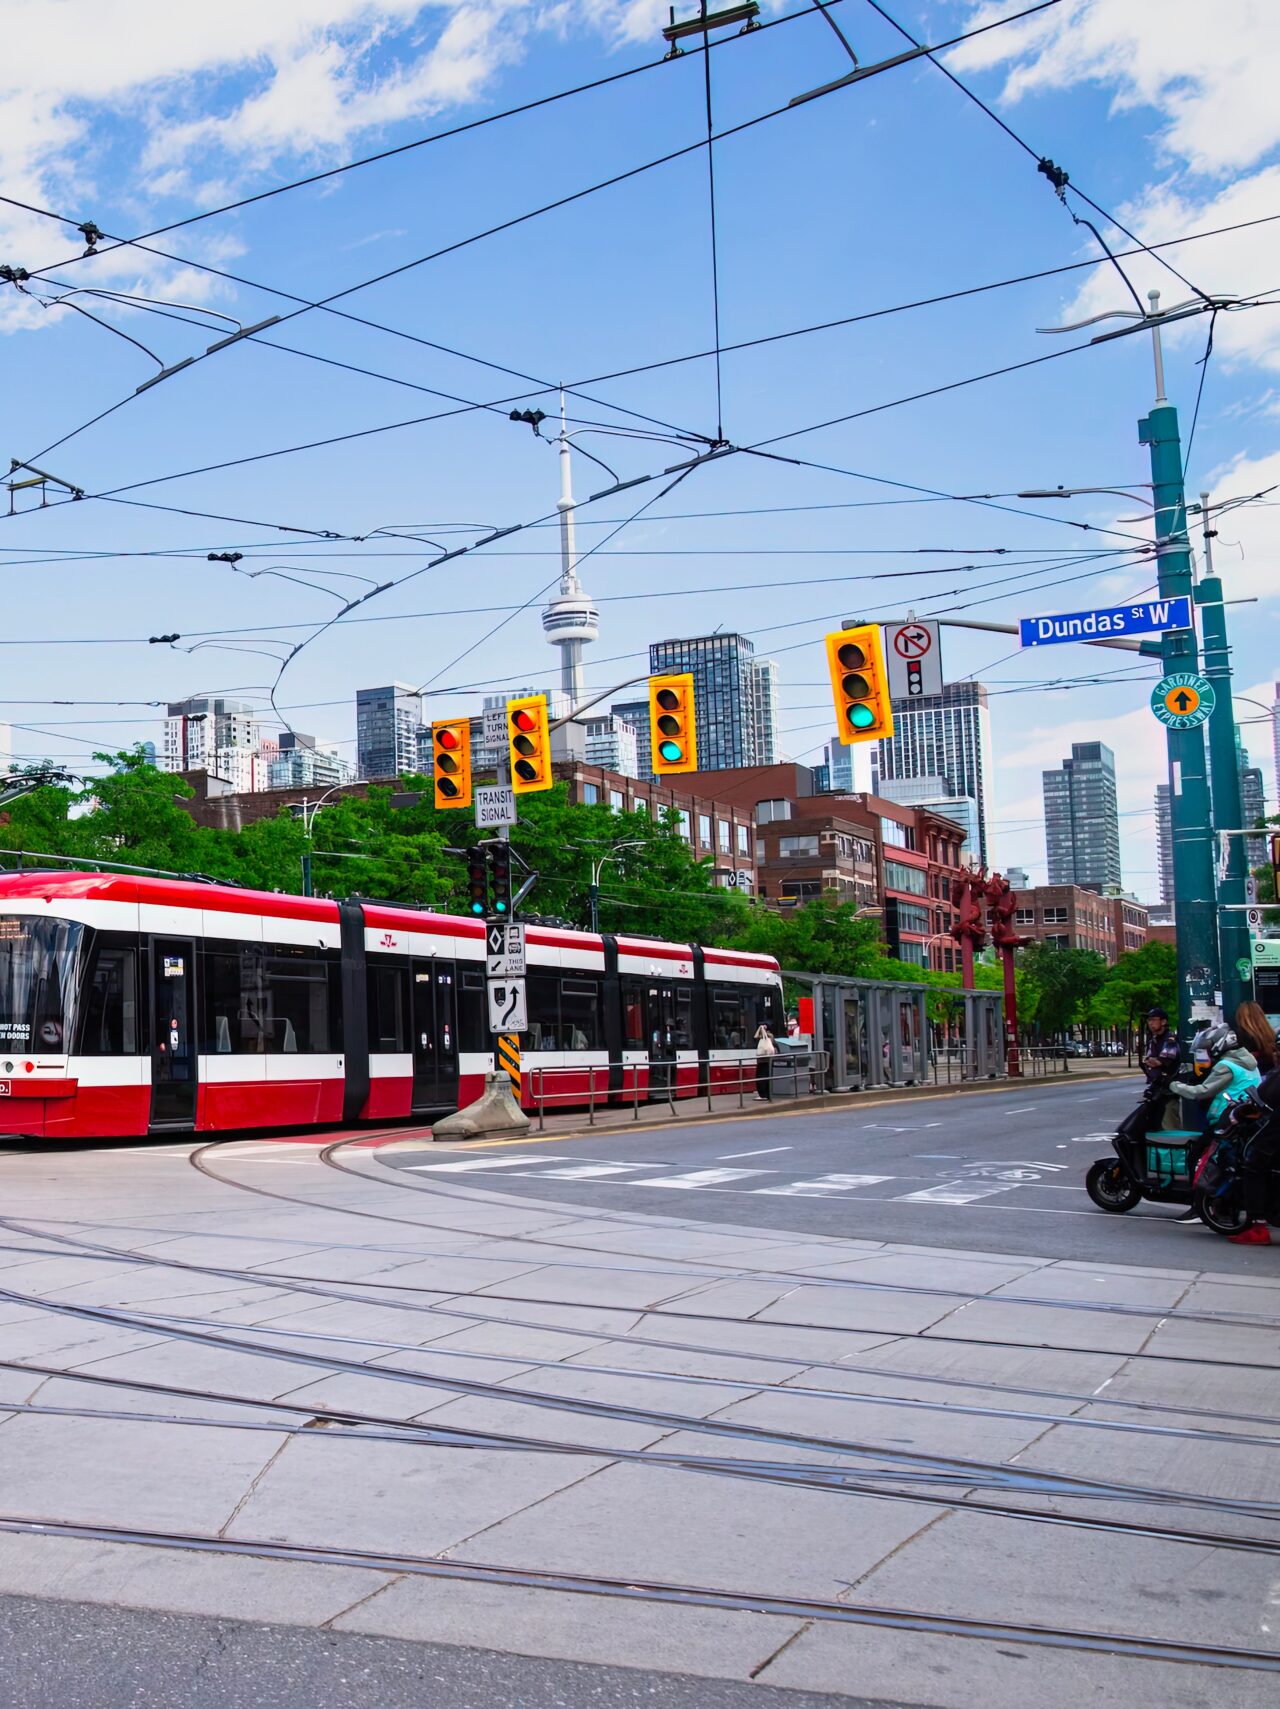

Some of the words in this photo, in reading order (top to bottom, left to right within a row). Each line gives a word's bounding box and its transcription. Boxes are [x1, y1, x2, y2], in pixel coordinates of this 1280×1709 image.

[1038, 613, 1125, 638] Dundas
[1131, 607, 1144, 619] St
[1149, 602, 1169, 624] W
[486, 712, 506, 721] LEFT
[1153, 701, 1213, 728] EXPRESSWAY
[486, 723, 509, 732] TURN
[478, 790, 513, 805] TRANSIT
[481, 807, 511, 821] SIGNAL
[7, 1032, 30, 1040] DOORS
